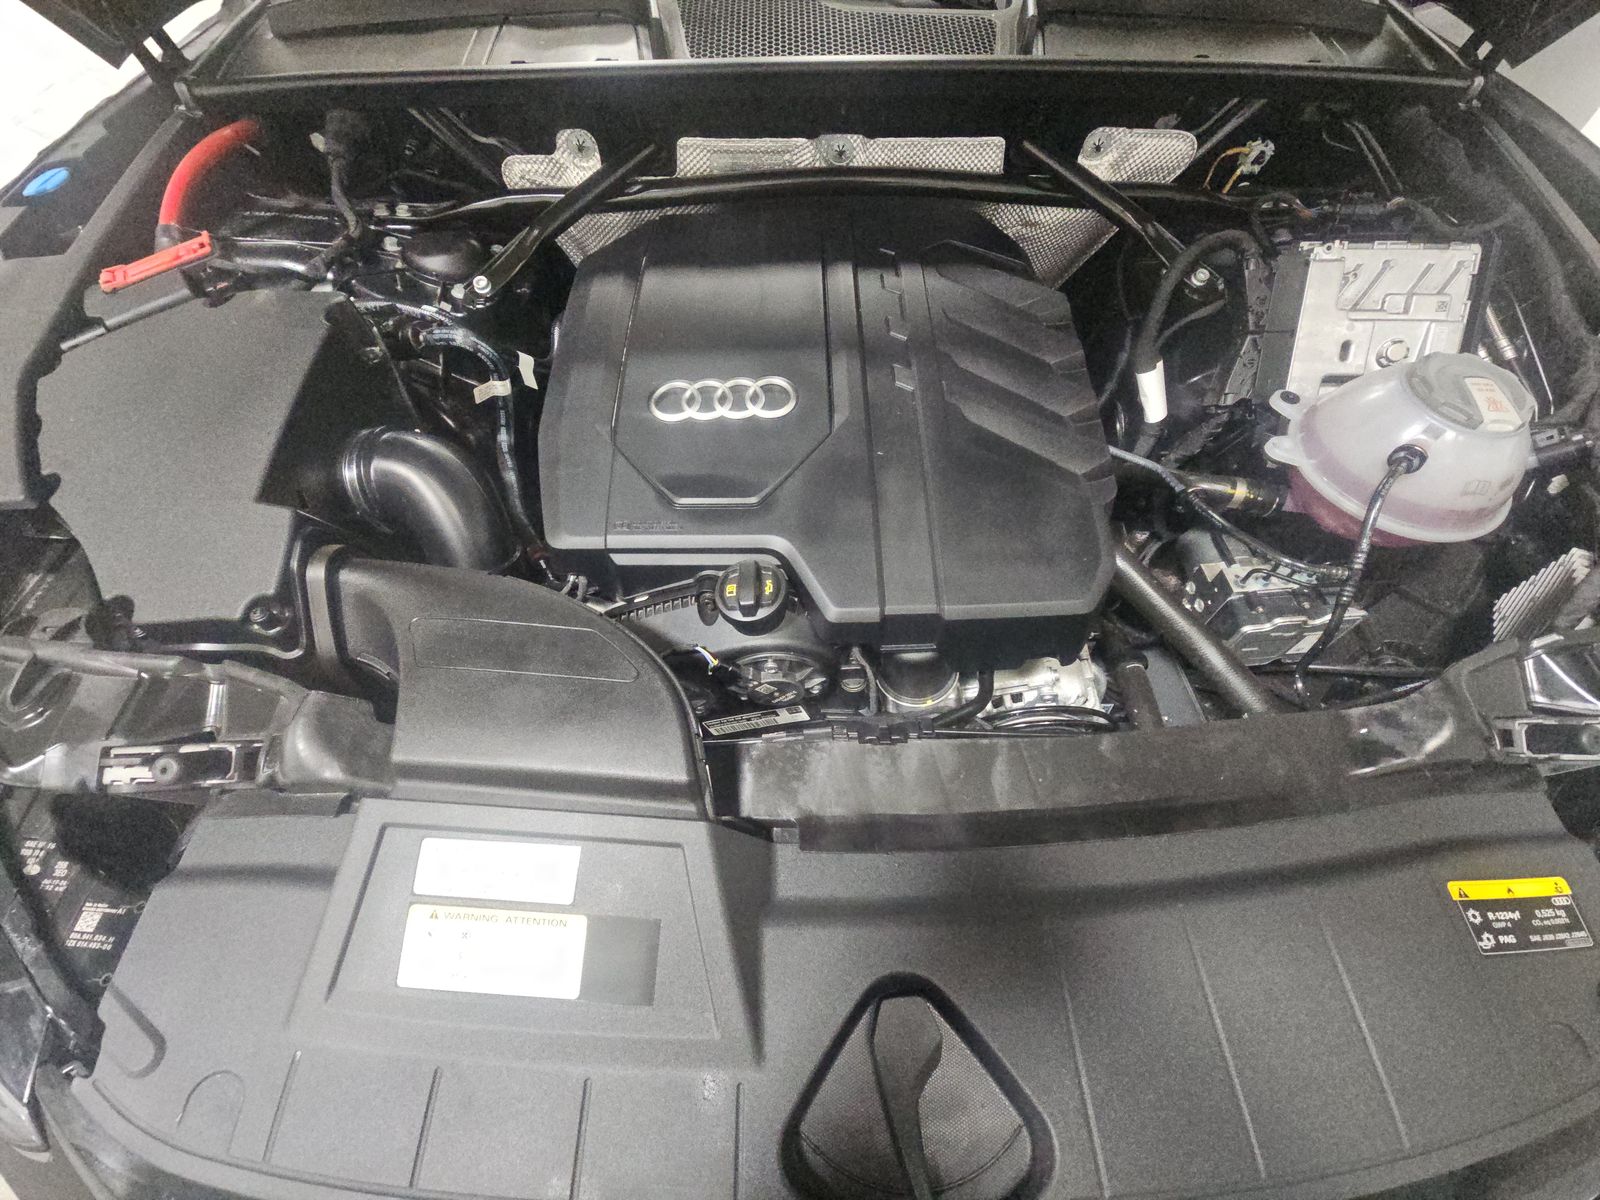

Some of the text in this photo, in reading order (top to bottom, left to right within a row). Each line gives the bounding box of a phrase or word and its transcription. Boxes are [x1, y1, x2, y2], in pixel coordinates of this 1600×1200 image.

[444, 911, 568, 928] WARNING ATTENTION
[1487, 910, 1521, 921] R-1234yf
[1555, 908, 1567, 918] kg
[1498, 934, 1517, 944] PAG
